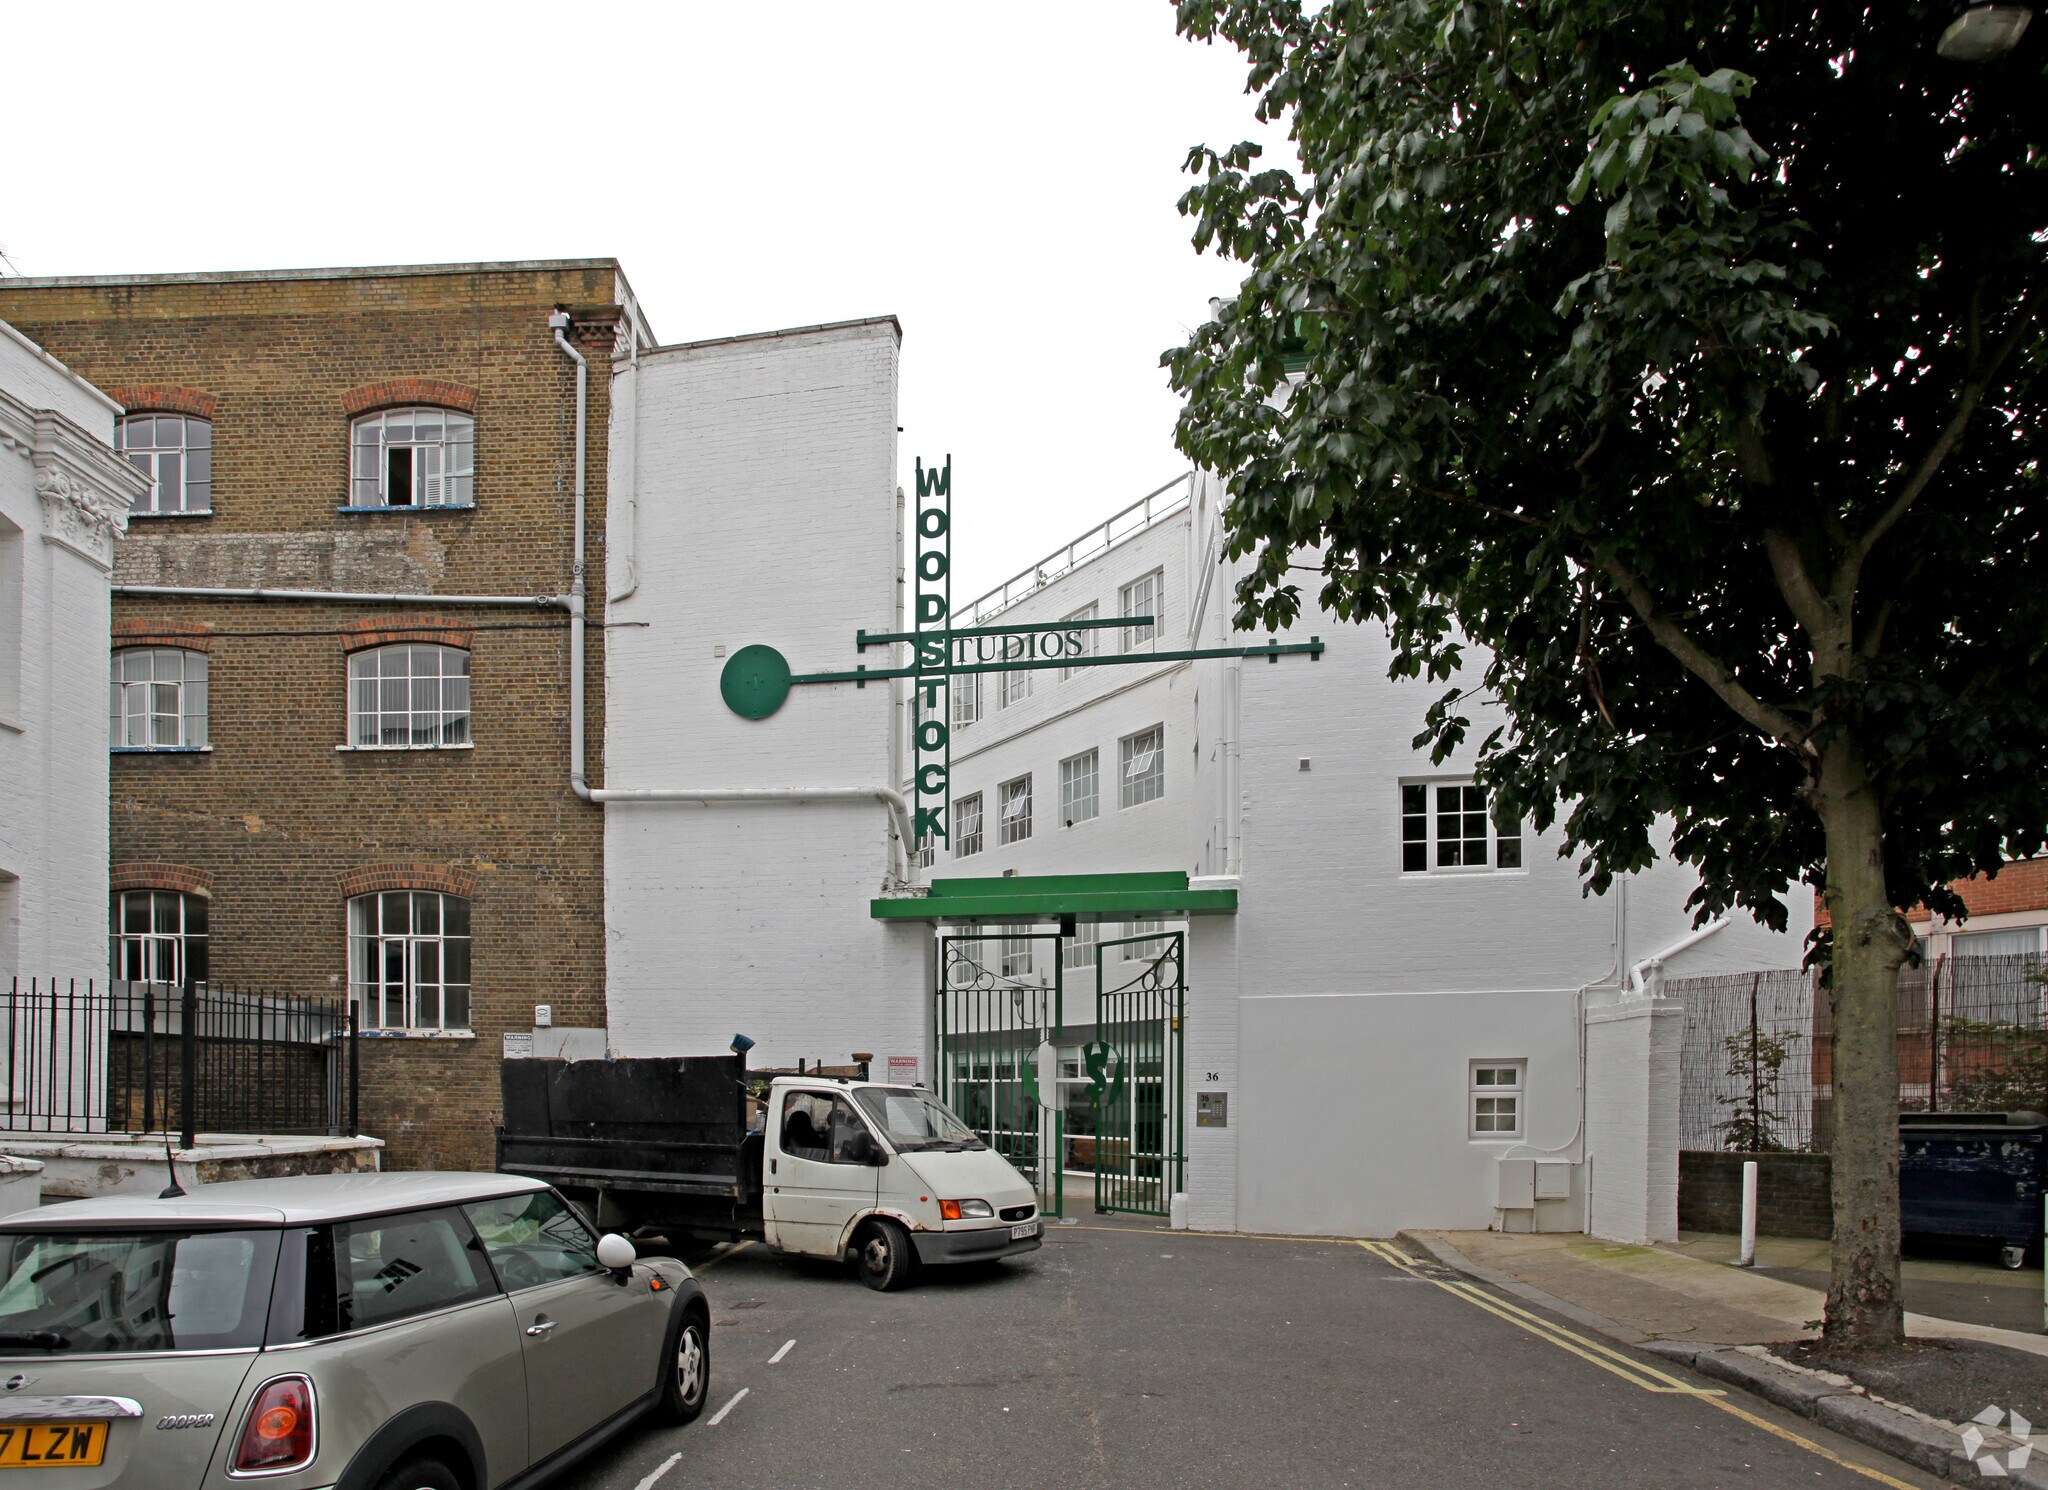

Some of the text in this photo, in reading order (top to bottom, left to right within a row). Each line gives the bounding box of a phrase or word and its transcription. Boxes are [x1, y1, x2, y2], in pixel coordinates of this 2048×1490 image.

[915, 467, 950, 837] WOODSTOCK
[1205, 1072, 1219, 1082] 36
[1200, 1094, 1210, 1102] 36
[156, 1413, 214, 1430] COOPER
[21, 1426, 93, 1461] LZW
